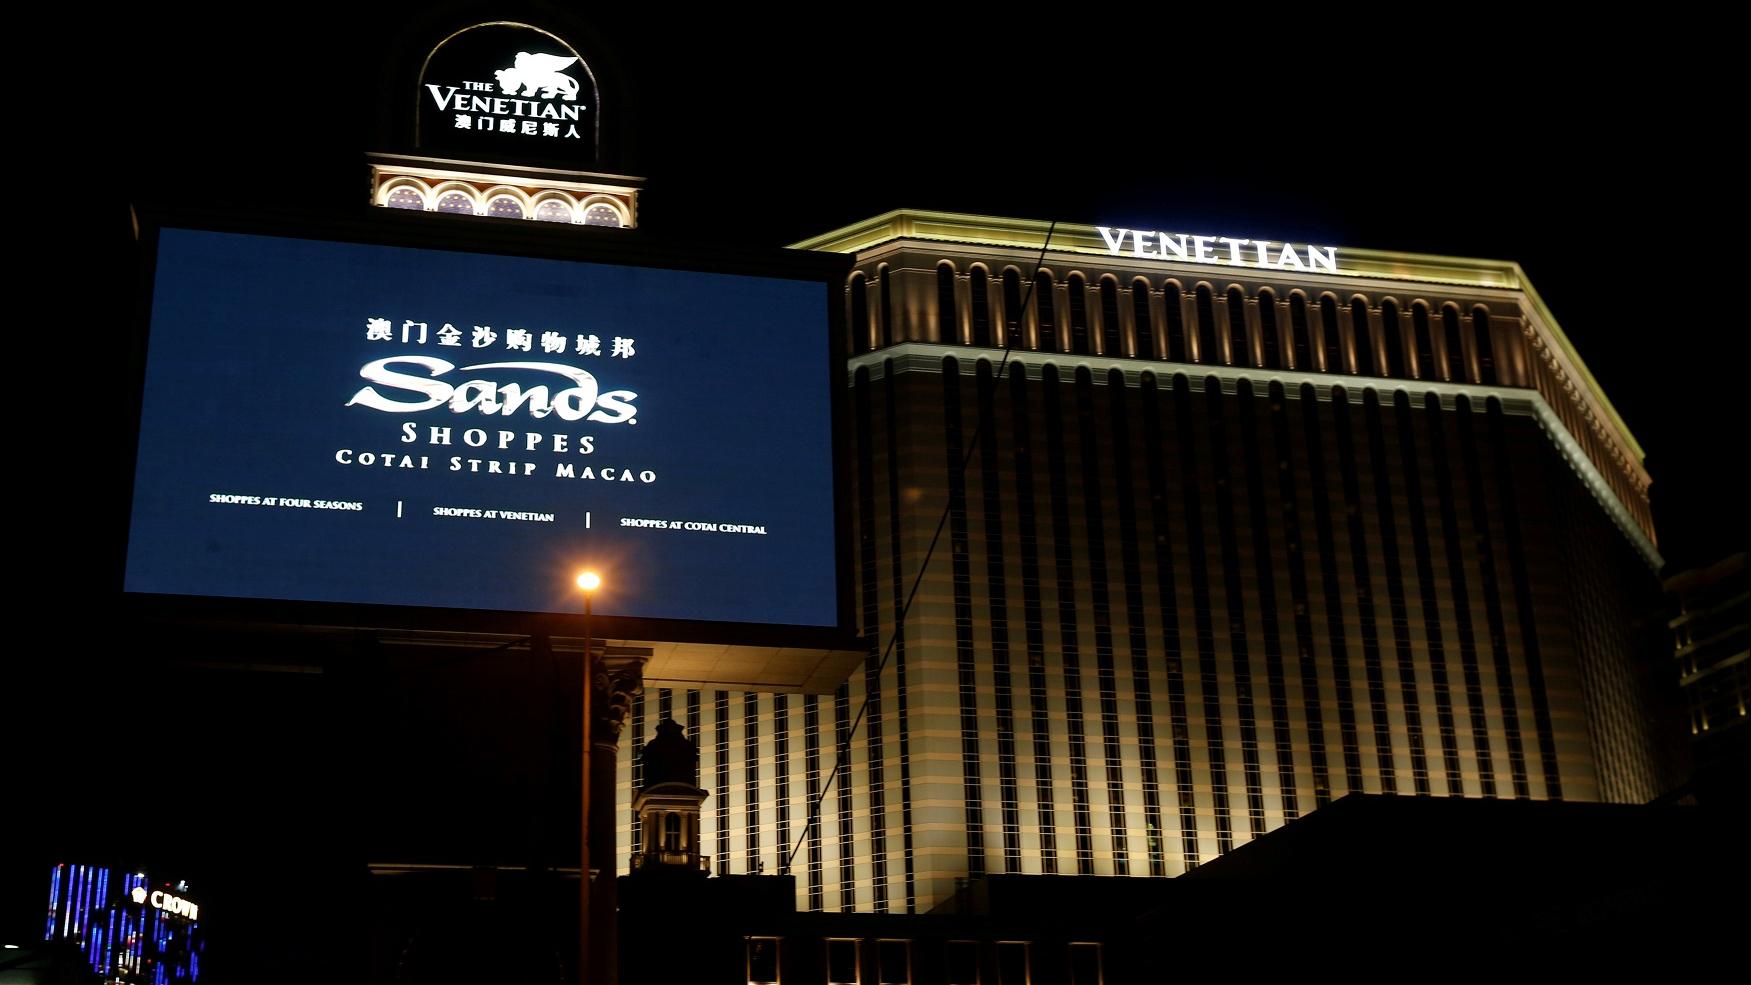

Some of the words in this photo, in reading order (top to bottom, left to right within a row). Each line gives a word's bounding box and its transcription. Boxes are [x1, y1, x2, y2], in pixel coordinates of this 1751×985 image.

[462, 81, 494, 92] THE
[454, 114, 581, 139] 澳门威尼斯人
[1095, 226, 1338, 274] VENETIAN
[366, 317, 636, 359] 澳门金沙购物城邦
[401, 422, 595, 454] SHOPPES
[335, 449, 430, 469] COTAI
[449, 457, 537, 476] STRIP
[555, 463, 657, 483] MACAO
[209, 493, 261, 505] SHOPPES
[262, 497, 278, 506] AT
[279, 498, 312, 508] FOUR
[313, 500, 363, 511] SEASONS
[433, 507, 482, 518] SHOPPES
[483, 511, 499, 519] AT
[499, 511, 554, 522] VENETIAN
[620, 518, 667, 529] SHOPPES
[669, 521, 684, 529] AT
[684, 521, 717, 532] COTAI
[719, 523, 767, 534] CENTRAL
[151, 890, 198, 921] CROWN
